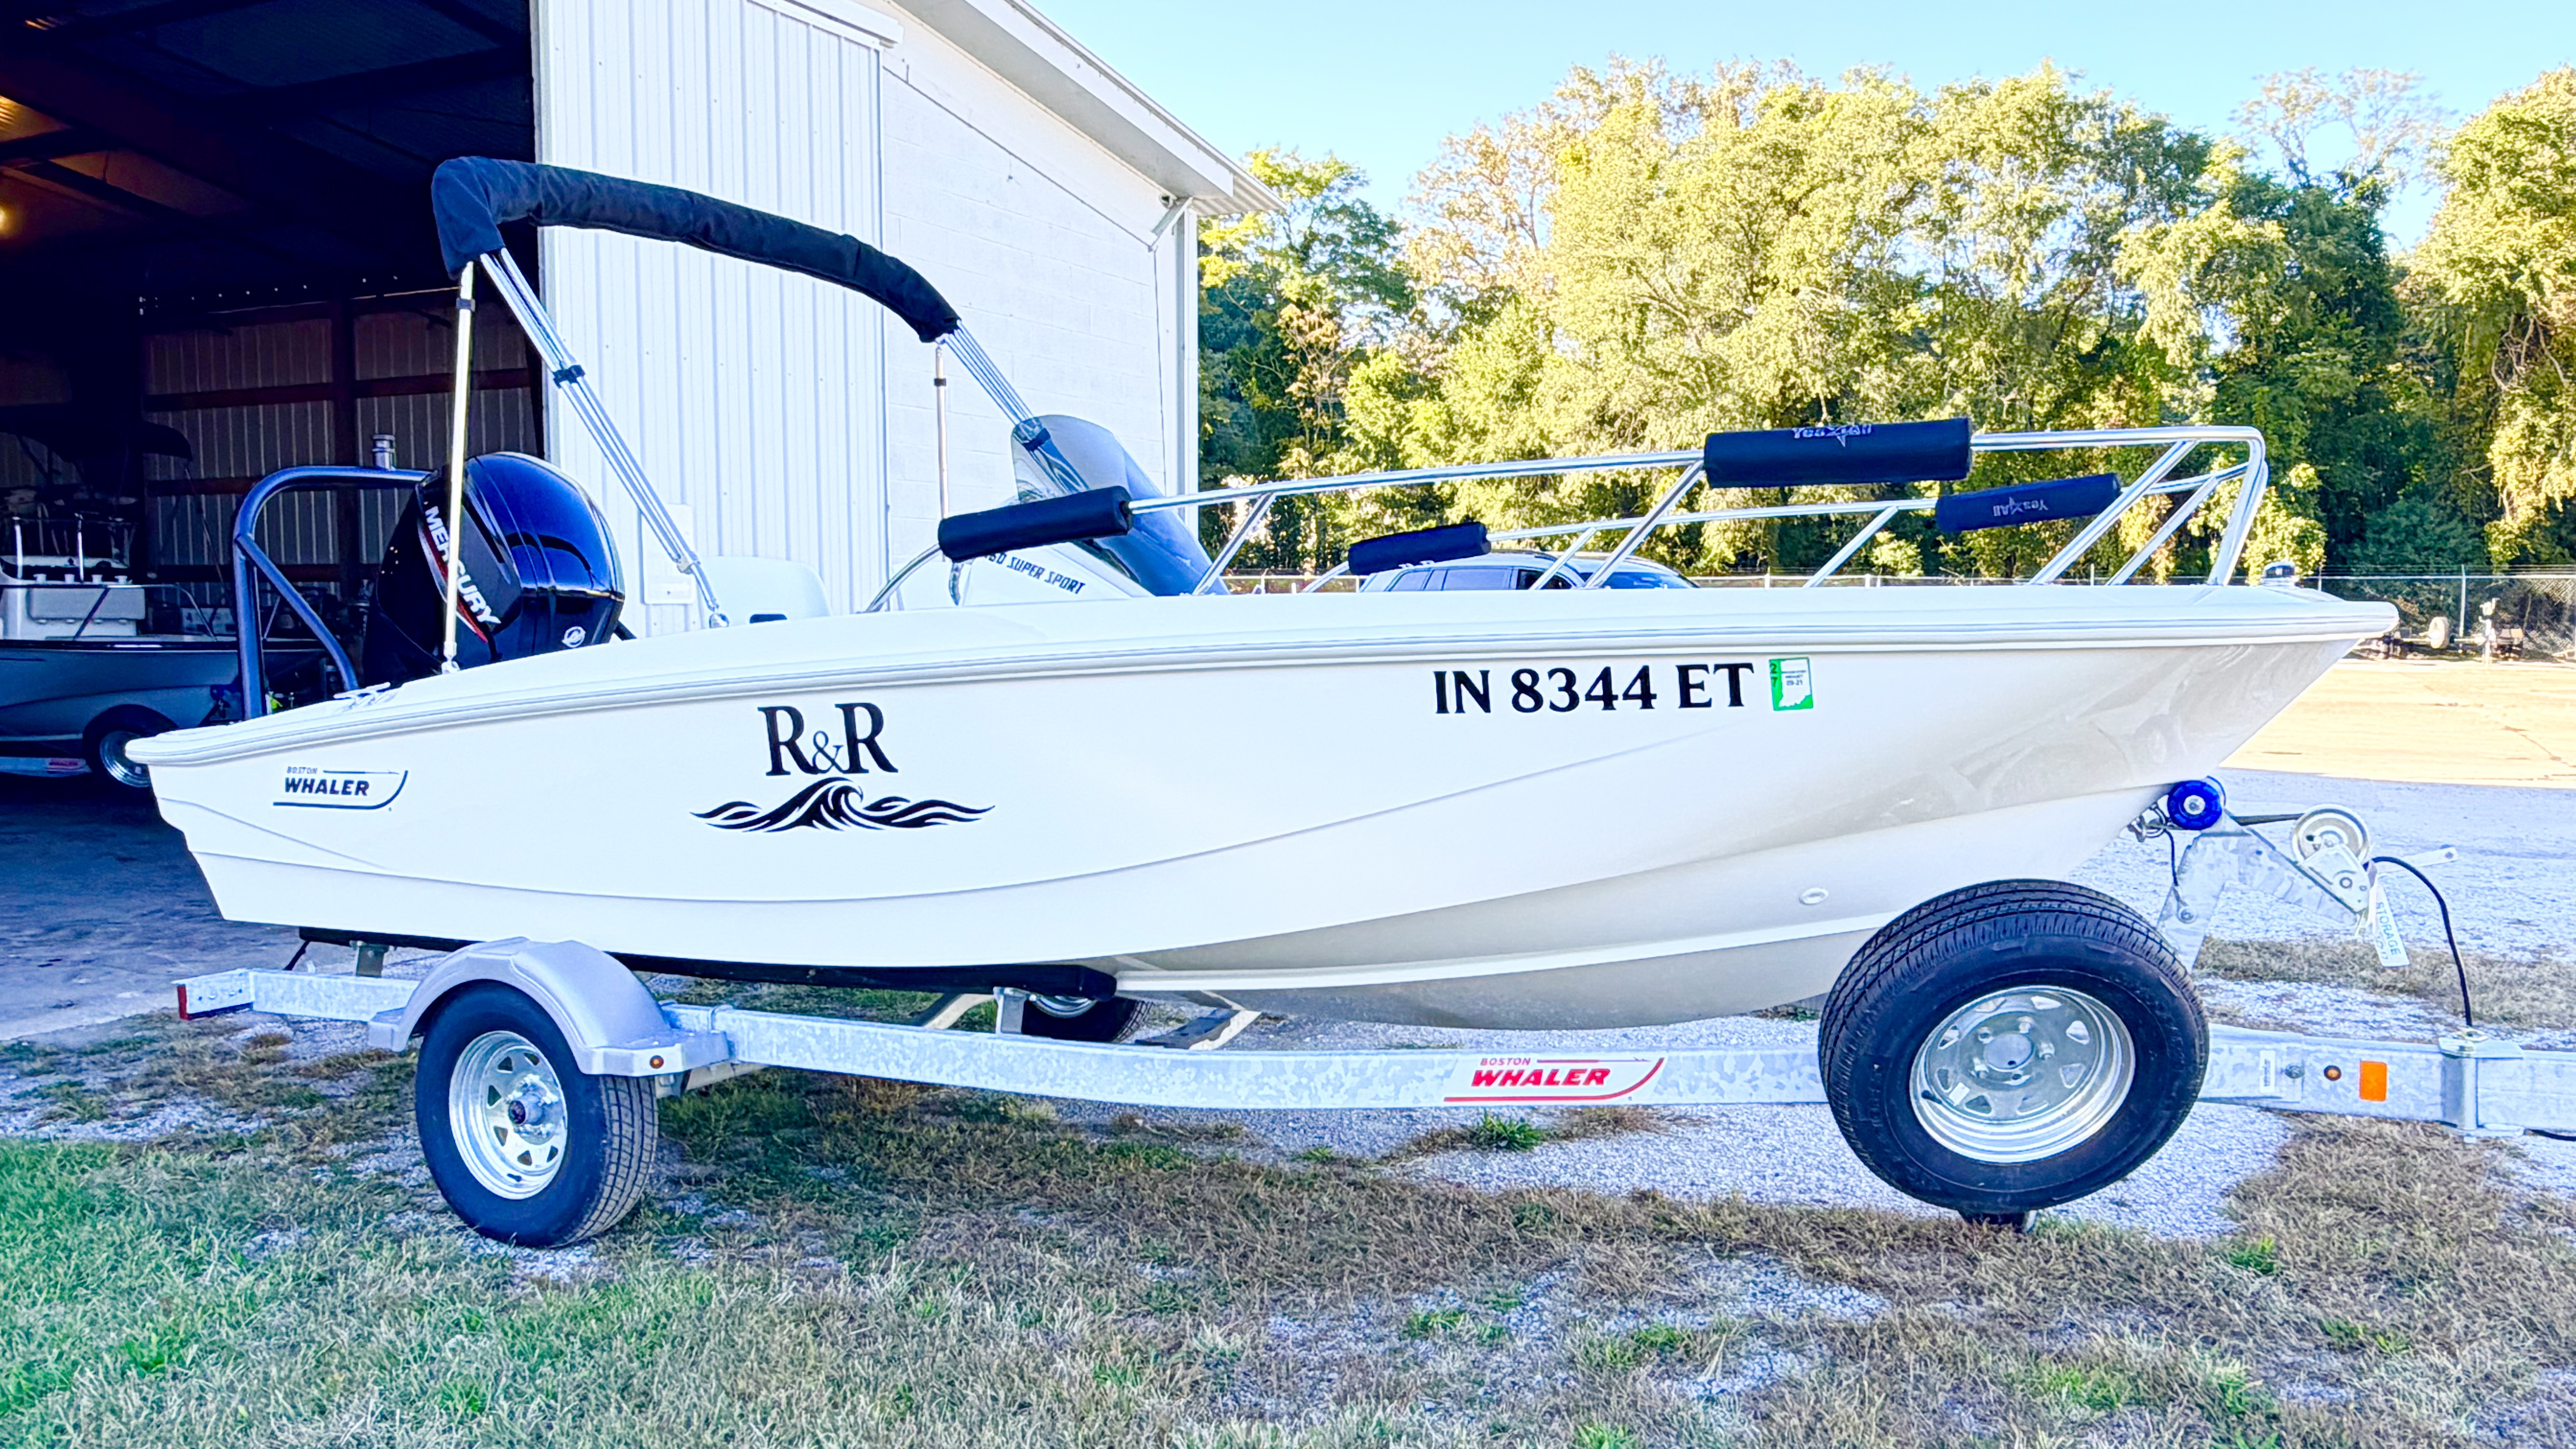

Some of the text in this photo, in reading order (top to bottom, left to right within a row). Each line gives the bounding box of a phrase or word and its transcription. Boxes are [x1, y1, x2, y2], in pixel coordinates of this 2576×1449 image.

[1007, 556, 1045, 579] SUPER
[1044, 571, 1086, 594] SPORT
[1433, 663, 1754, 713] IN 8344 ET
[758, 702, 898, 776] R&R
[286, 766, 317, 774] BOSTON
[285, 777, 369, 796] WHALER
[2376, 901, 2401, 955] STORAGE
[1480, 1058, 1531, 1066] BOSTON
[1471, 1068, 1611, 1087] WHALER
